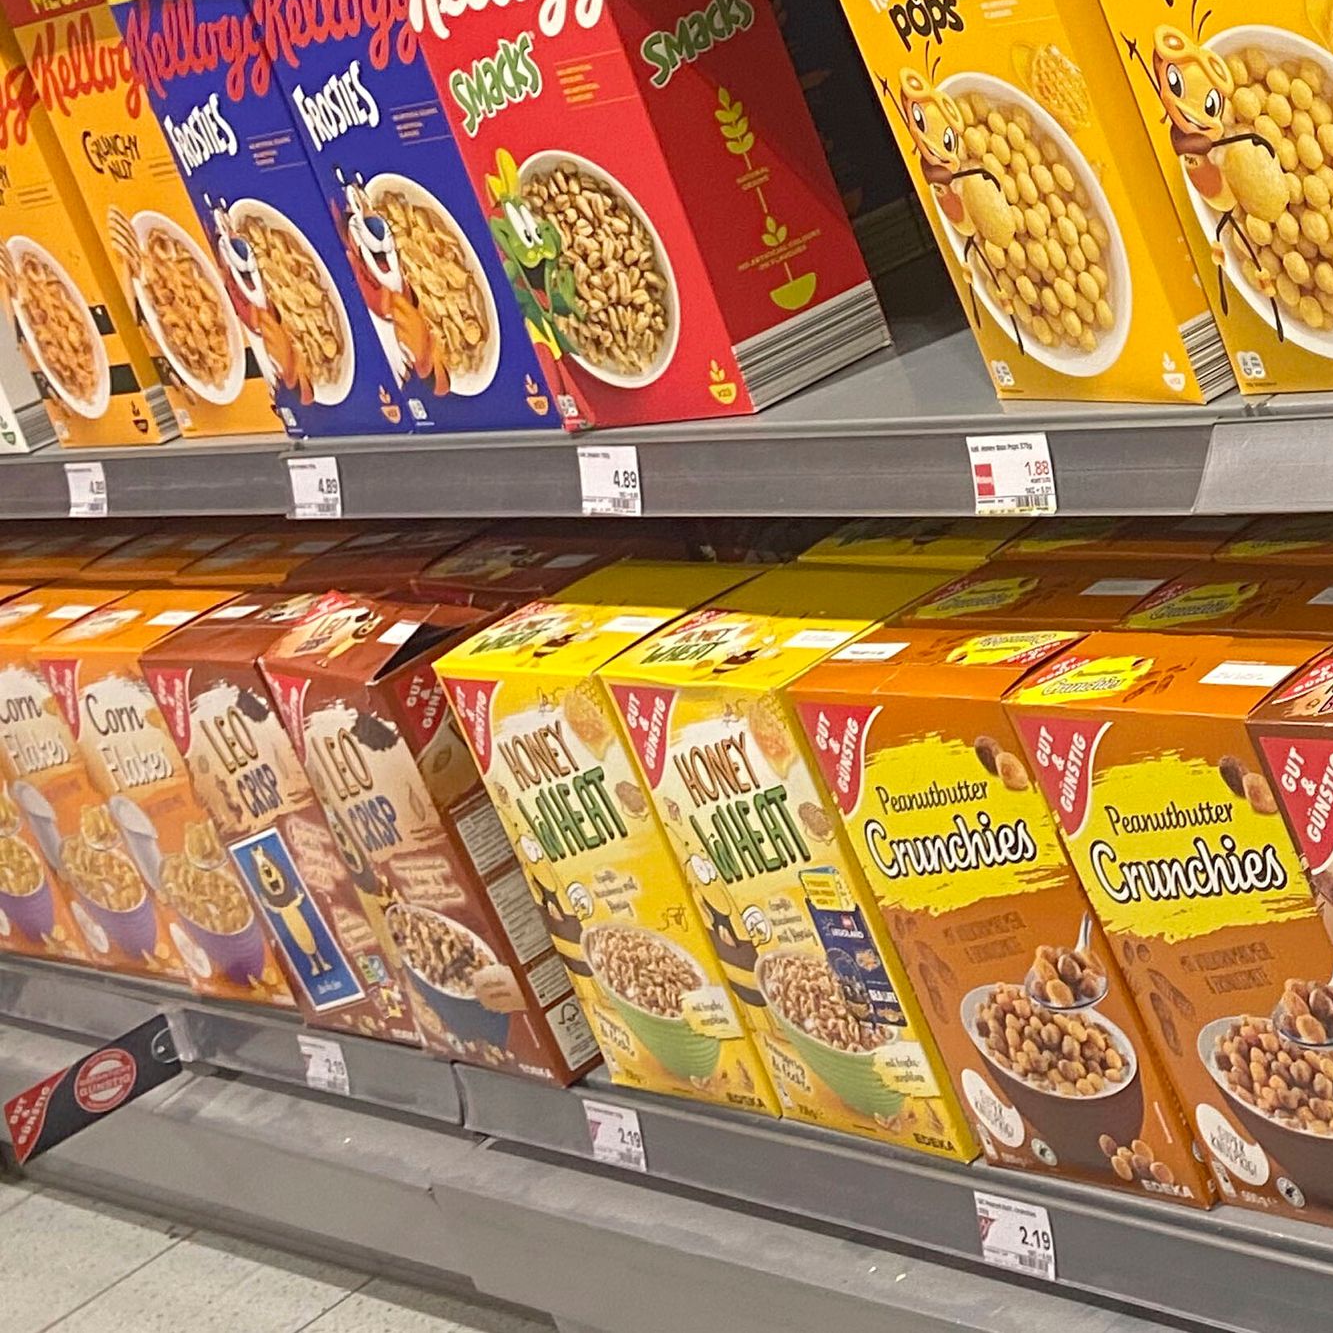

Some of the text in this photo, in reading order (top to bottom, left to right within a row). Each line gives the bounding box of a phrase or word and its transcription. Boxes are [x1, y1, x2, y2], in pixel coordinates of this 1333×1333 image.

[293, 59, 380, 152] FROSTIES
[613, 470, 637, 488] 4.89
[1025, 460, 1050, 476] 1.88
[84, 692, 146, 737] Corn
[199, 705, 258, 773] LEO
[311, 727, 374, 801] LEO
[497, 721, 579, 792] HONEY
[673, 731, 761, 808] HONEY
[1060, 731, 1087, 814] GÜNSTIG
[1280, 746, 1304, 793] GUT
[516, 765, 628, 863] WHEAT
[876, 777, 988, 816] Peanutbutter
[1105, 800, 1234, 837] Peanutbutter
[689, 783, 811, 884] WHEAT
[864, 811, 1036, 880] Crunchies
[1089, 838, 1288, 905] Crunchies
[913, 1132, 955, 1152] EDEKA
[1019, 1226, 1051, 1251] 2.19
